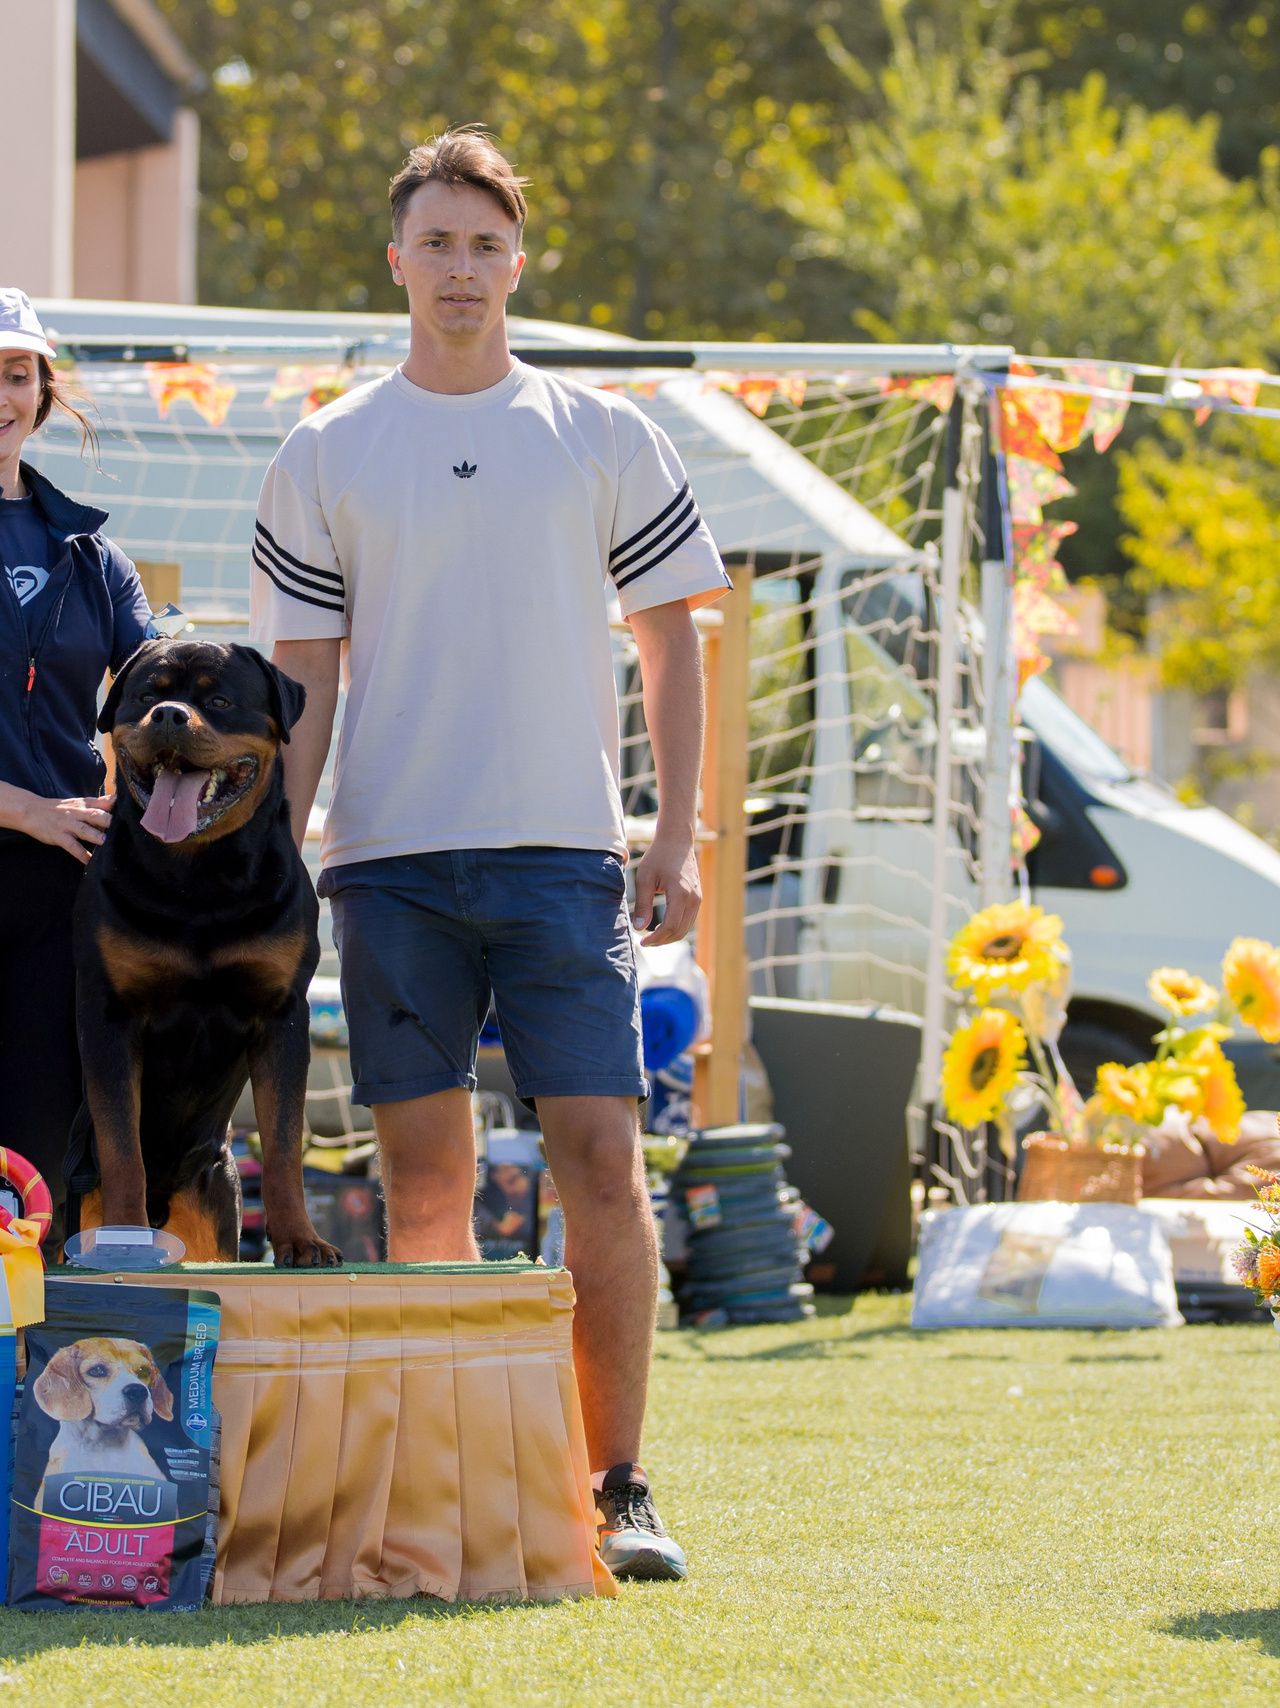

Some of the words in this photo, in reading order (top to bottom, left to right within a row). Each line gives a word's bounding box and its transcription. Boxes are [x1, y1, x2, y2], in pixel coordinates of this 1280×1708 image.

[194, 1322, 207, 1361] BREED
[189, 1361, 201, 1409] MEDIUM
[59, 1480, 162, 1517] CIBAU
[64, 1530, 150, 1556] ADULT
[71, 1595, 108, 1606] MAINTENANCE
